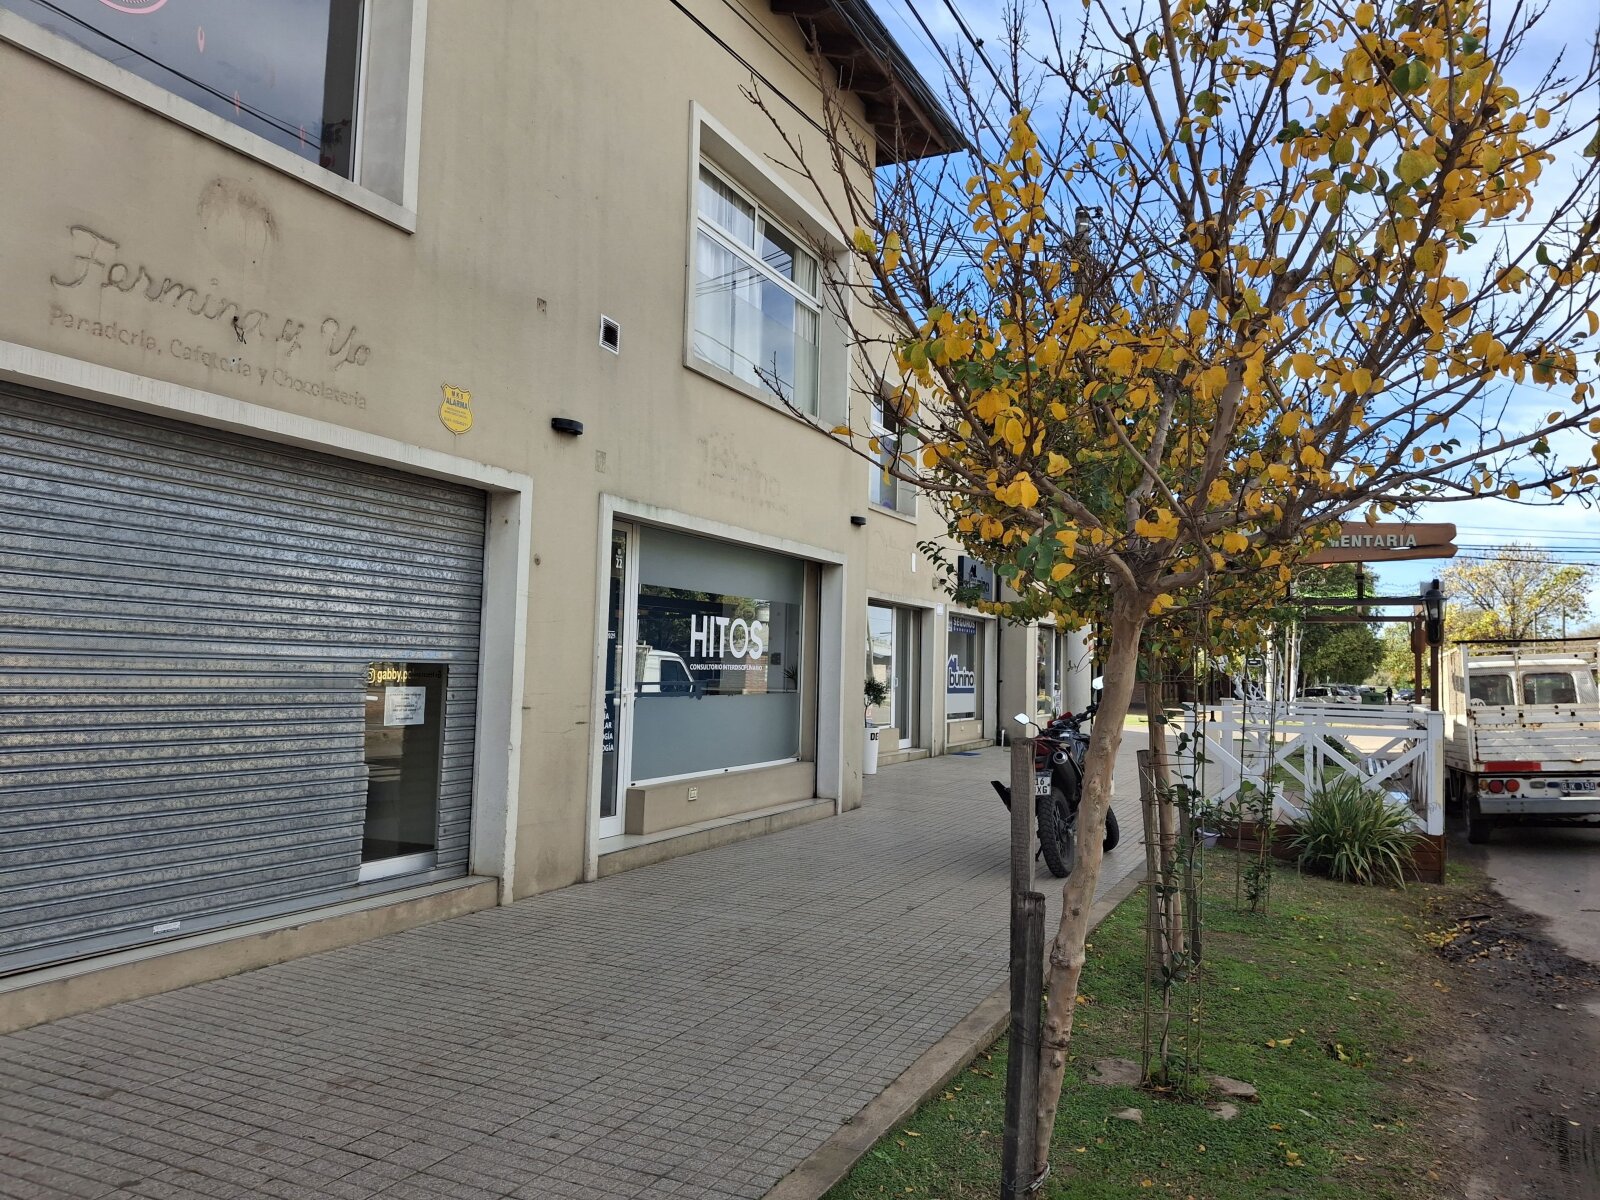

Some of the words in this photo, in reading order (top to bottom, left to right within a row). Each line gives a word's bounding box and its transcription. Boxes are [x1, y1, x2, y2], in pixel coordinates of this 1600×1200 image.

[50, 224, 270, 338] Fermina
[690, 614, 763, 660] HITOS
[689, 663, 723, 671] CONSULTORIO
